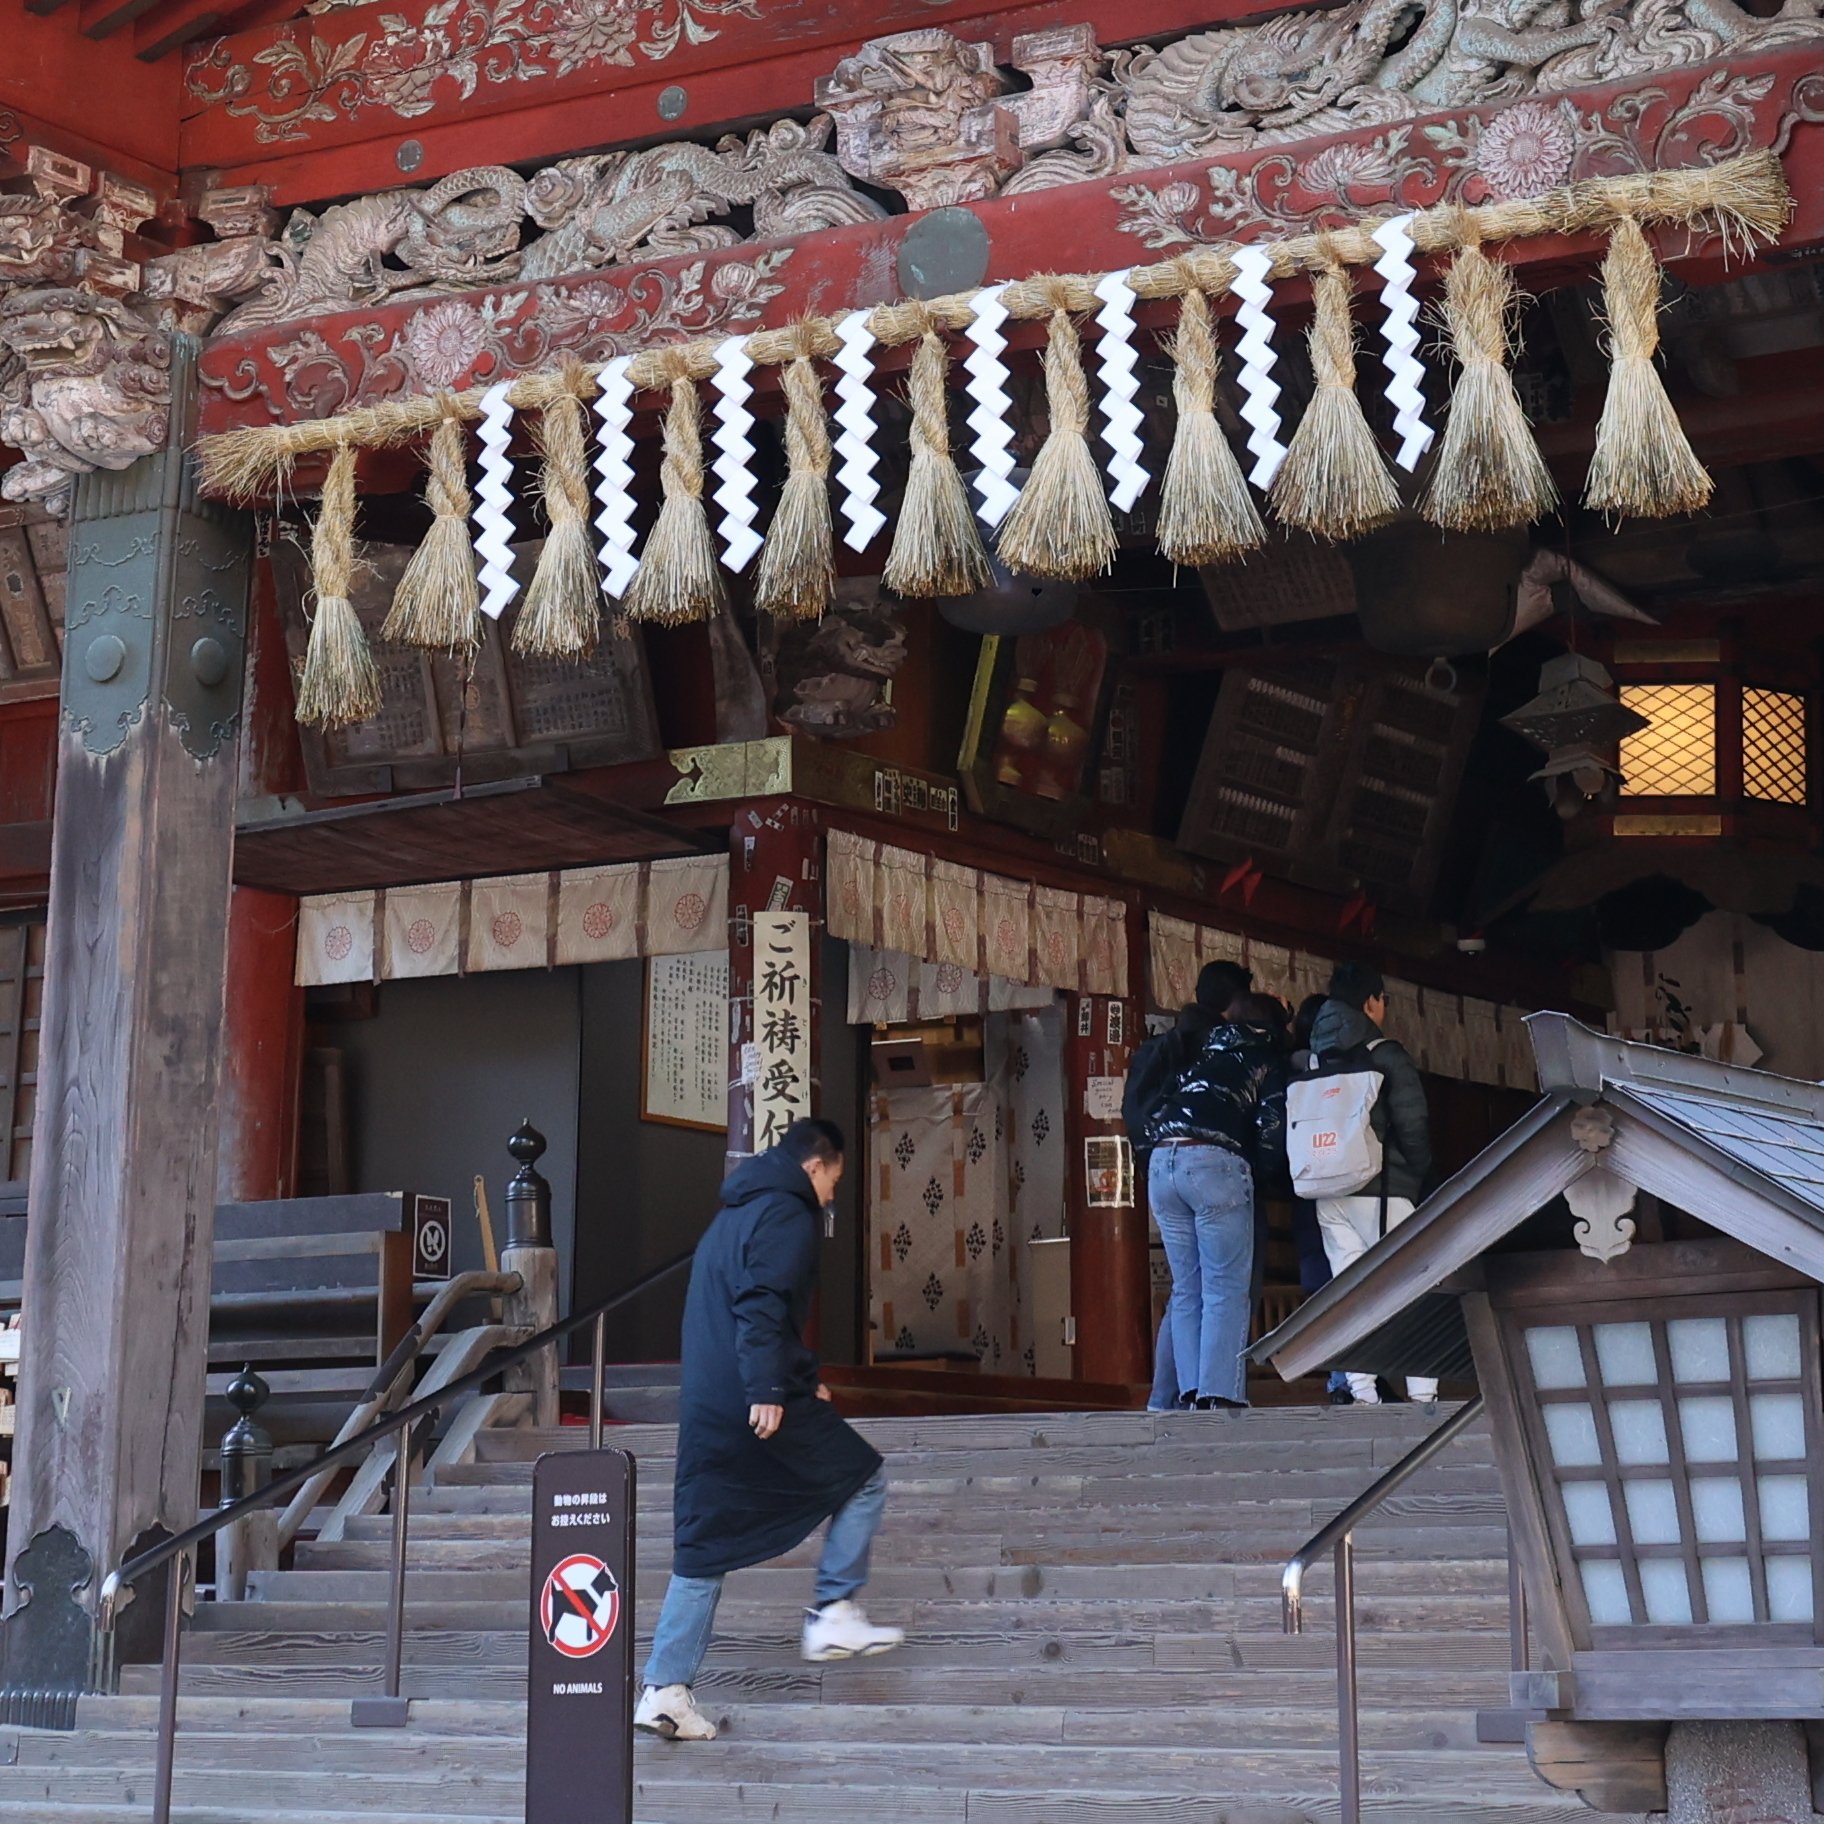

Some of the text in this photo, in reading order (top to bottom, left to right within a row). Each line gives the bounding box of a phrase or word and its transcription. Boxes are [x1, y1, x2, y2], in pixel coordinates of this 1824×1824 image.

[553, 1493, 608, 1507] 動物の昇段は
[551, 1513, 611, 1527] お控えください
[553, 1682, 603, 1695] NO ANIMALS
